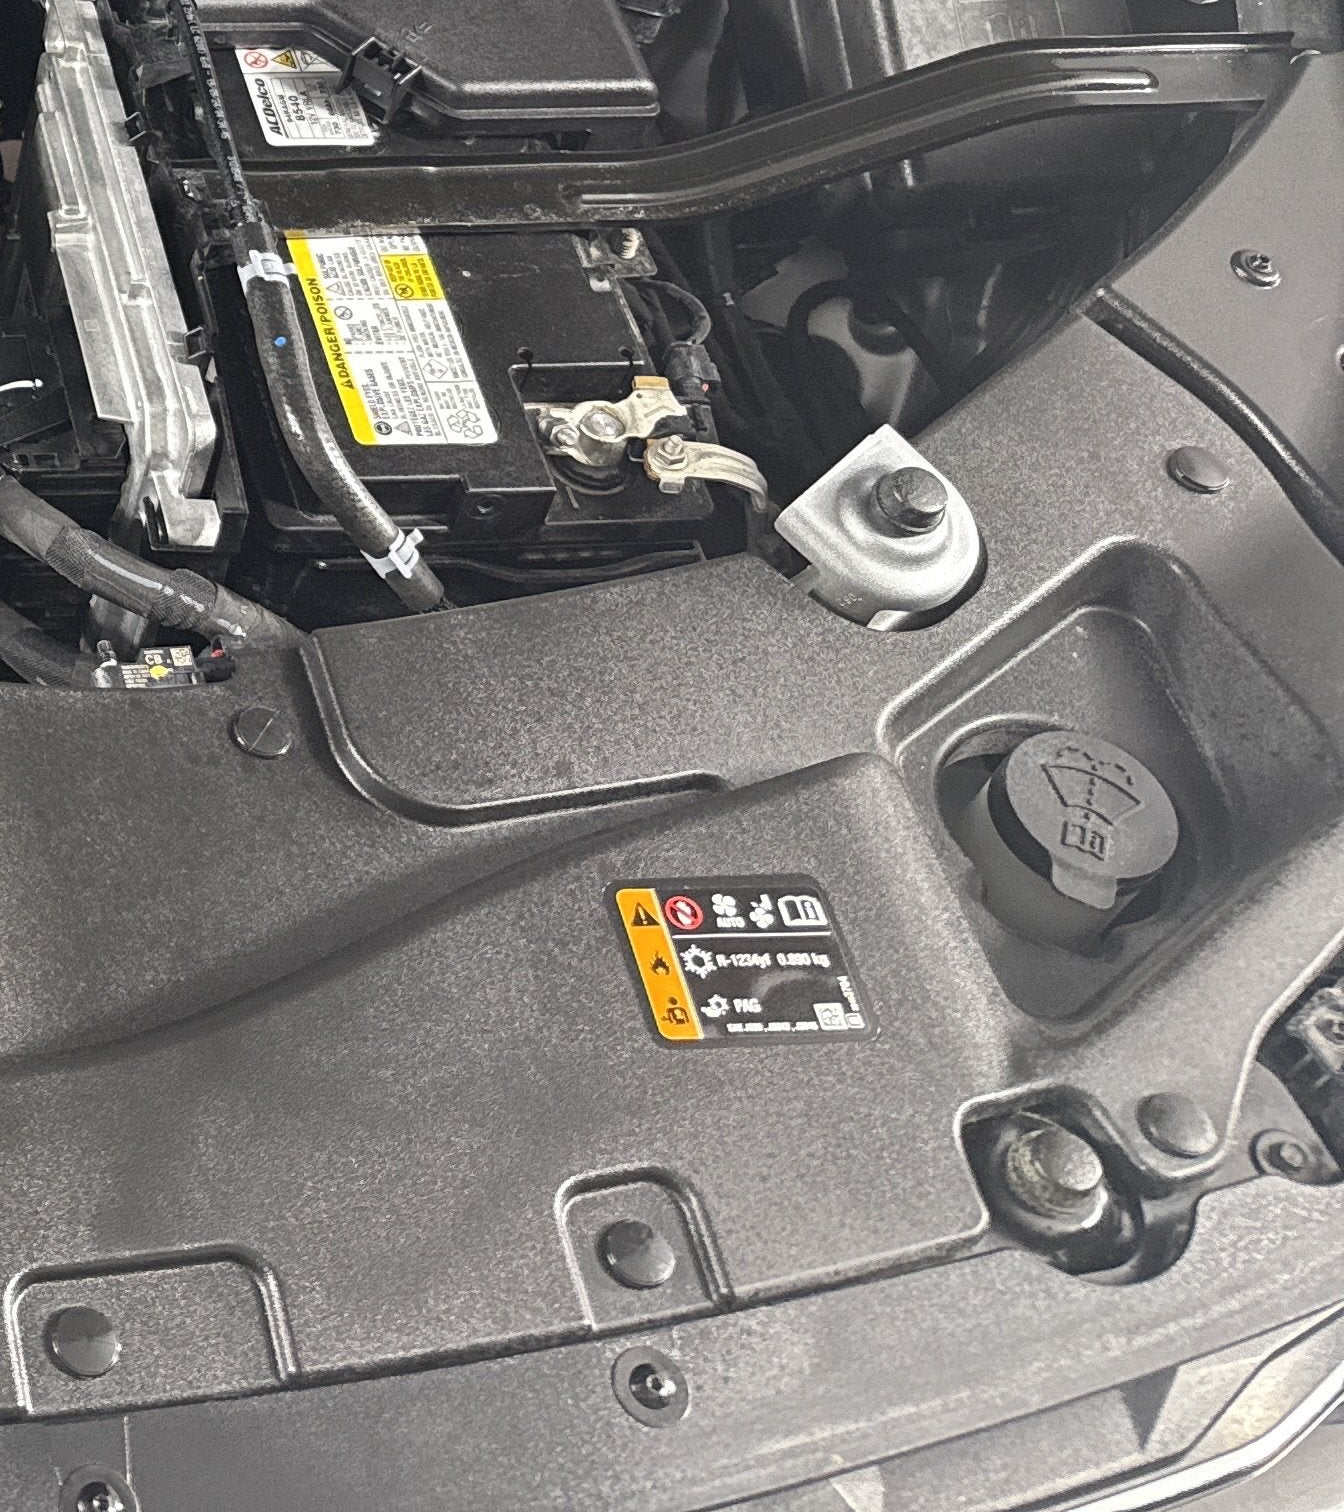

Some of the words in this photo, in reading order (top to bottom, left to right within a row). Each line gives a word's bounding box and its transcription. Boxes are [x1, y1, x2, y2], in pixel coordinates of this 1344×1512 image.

[254, 78, 284, 135] ACDelco
[306, 278, 349, 378] DANGER/POISON
[732, 998, 762, 1013] PAG
